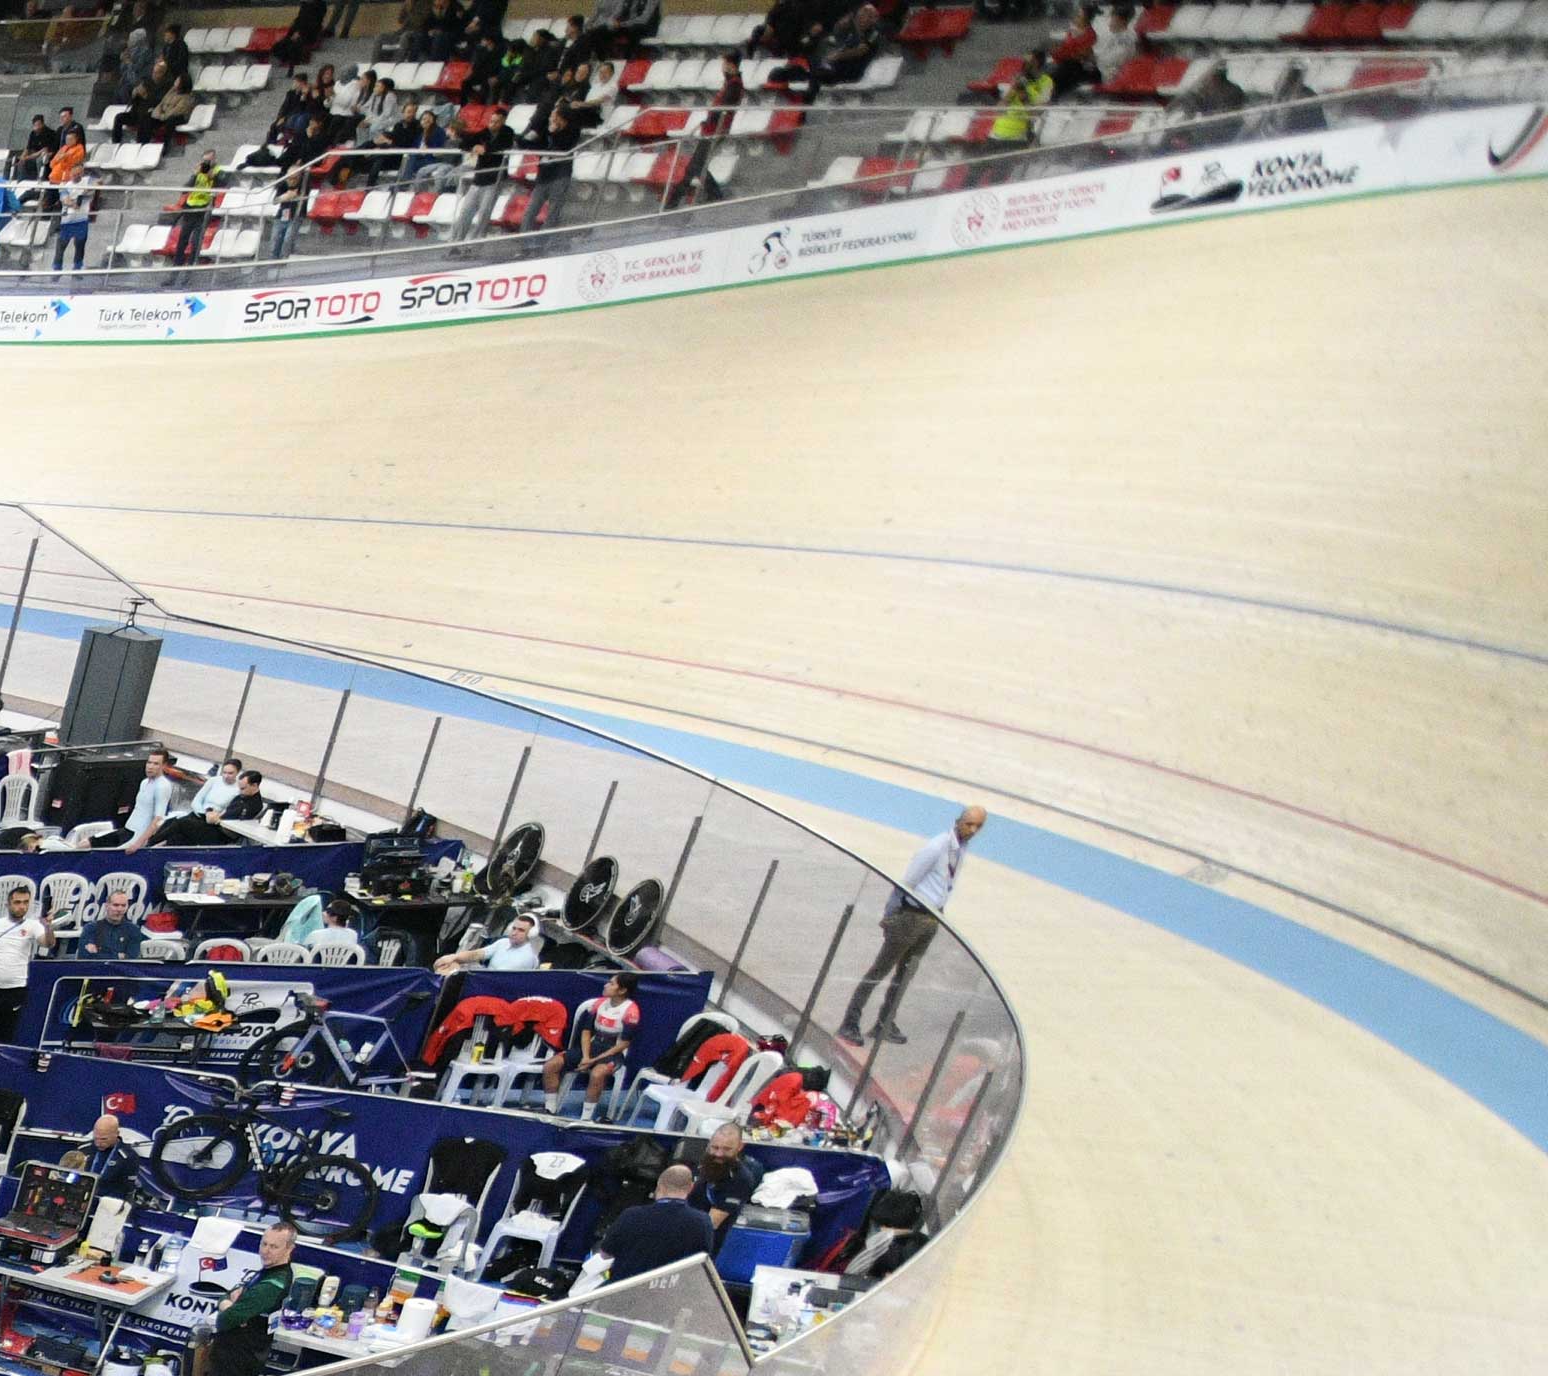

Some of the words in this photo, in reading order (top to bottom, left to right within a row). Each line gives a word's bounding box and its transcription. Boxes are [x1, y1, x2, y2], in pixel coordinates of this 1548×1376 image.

[1251, 149, 1323, 177] KONYA
[1247, 165, 1359, 197] VELODROME
[1004, 204, 1046, 218] MINISTRY
[1049, 202, 1062, 212] OF
[1064, 197, 1097, 211] YOUTH
[1007, 191, 1048, 207] REPUBLIC
[842, 231, 918, 251] FEDERASYONU
[689, 249, 705, 261] VE
[0, 310, 49, 324] Telekom
[98, 308, 124, 322] Türk
[128, 307, 182, 321] Telekom
[164, 1292, 219, 1316] KONY
[134, 1317, 188, 1338] EUROPEAN
